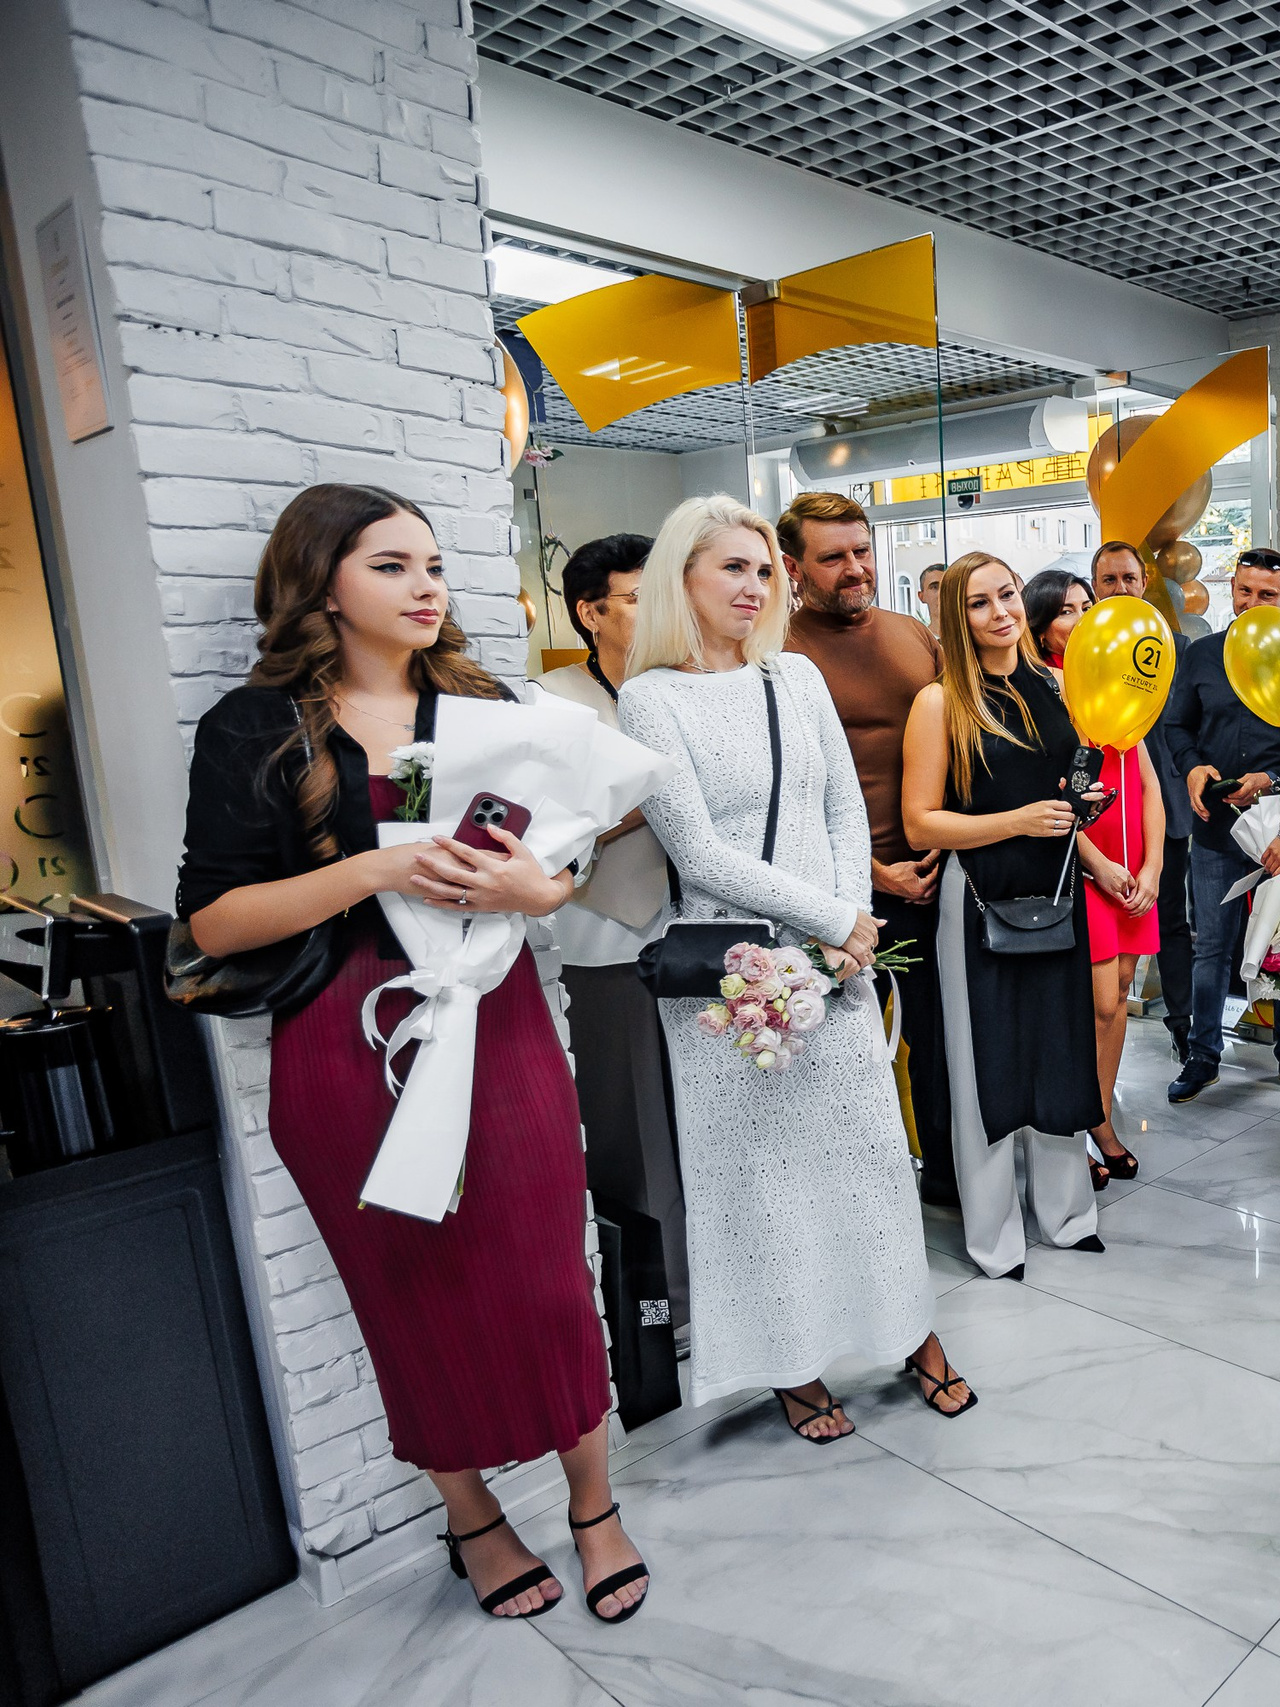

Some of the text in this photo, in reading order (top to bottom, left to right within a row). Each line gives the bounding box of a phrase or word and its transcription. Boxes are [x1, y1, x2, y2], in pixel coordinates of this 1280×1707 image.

[951, 479, 979, 493] ВЫХОД
[1142, 646, 1161, 669] 21
[1122, 674, 1153, 688] CENTURY
